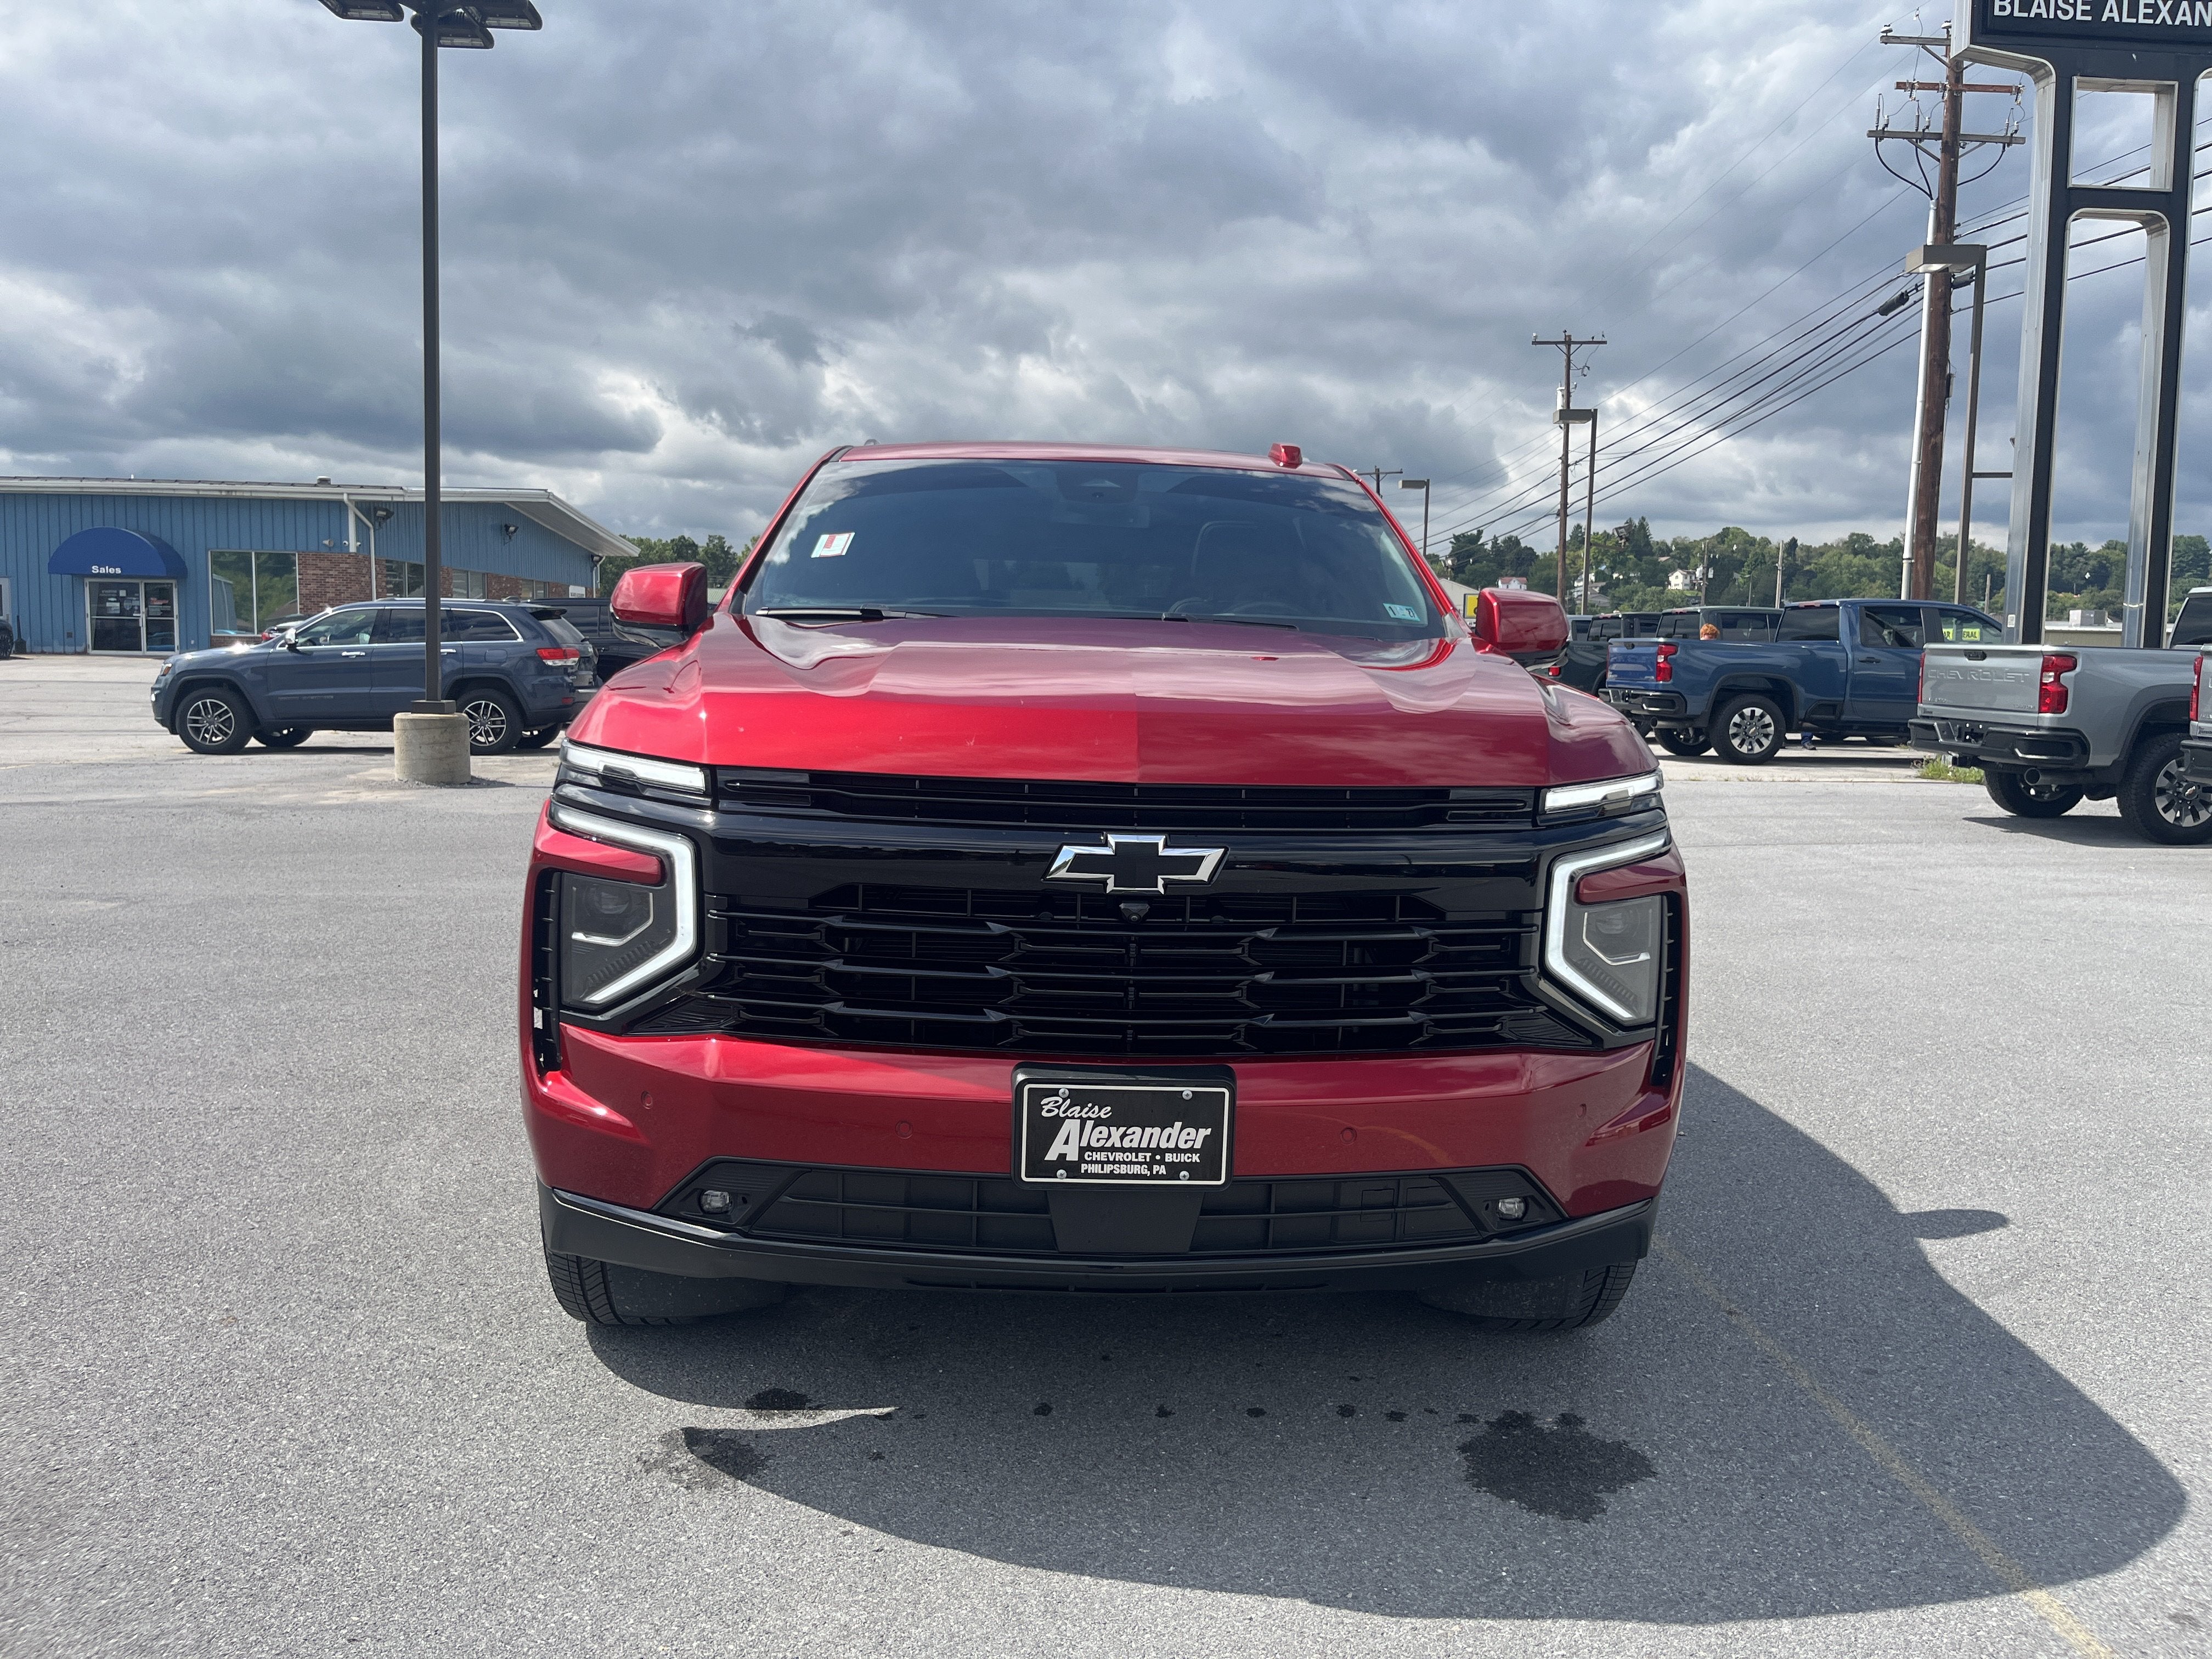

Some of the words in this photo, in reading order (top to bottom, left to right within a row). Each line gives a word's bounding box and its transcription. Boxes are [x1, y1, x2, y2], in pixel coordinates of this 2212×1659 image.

[1994, 0, 2092, 21] BLAISE
[2101, 0, 2212, 27] ALEXAN
[92, 565, 121, 574] Sales
[1928, 669, 2030, 682] CHEVROLET
[1040, 1096, 1113, 1119] Blaise
[1044, 1119, 1212, 1161] Alexander
[1084, 1151, 1152, 1162] CHEVROLET
[1165, 1153, 1200, 1163] BUICK
[1081, 1163, 1150, 1176] PHILIPSBURG,
[1153, 1164, 1166, 1175] PA
